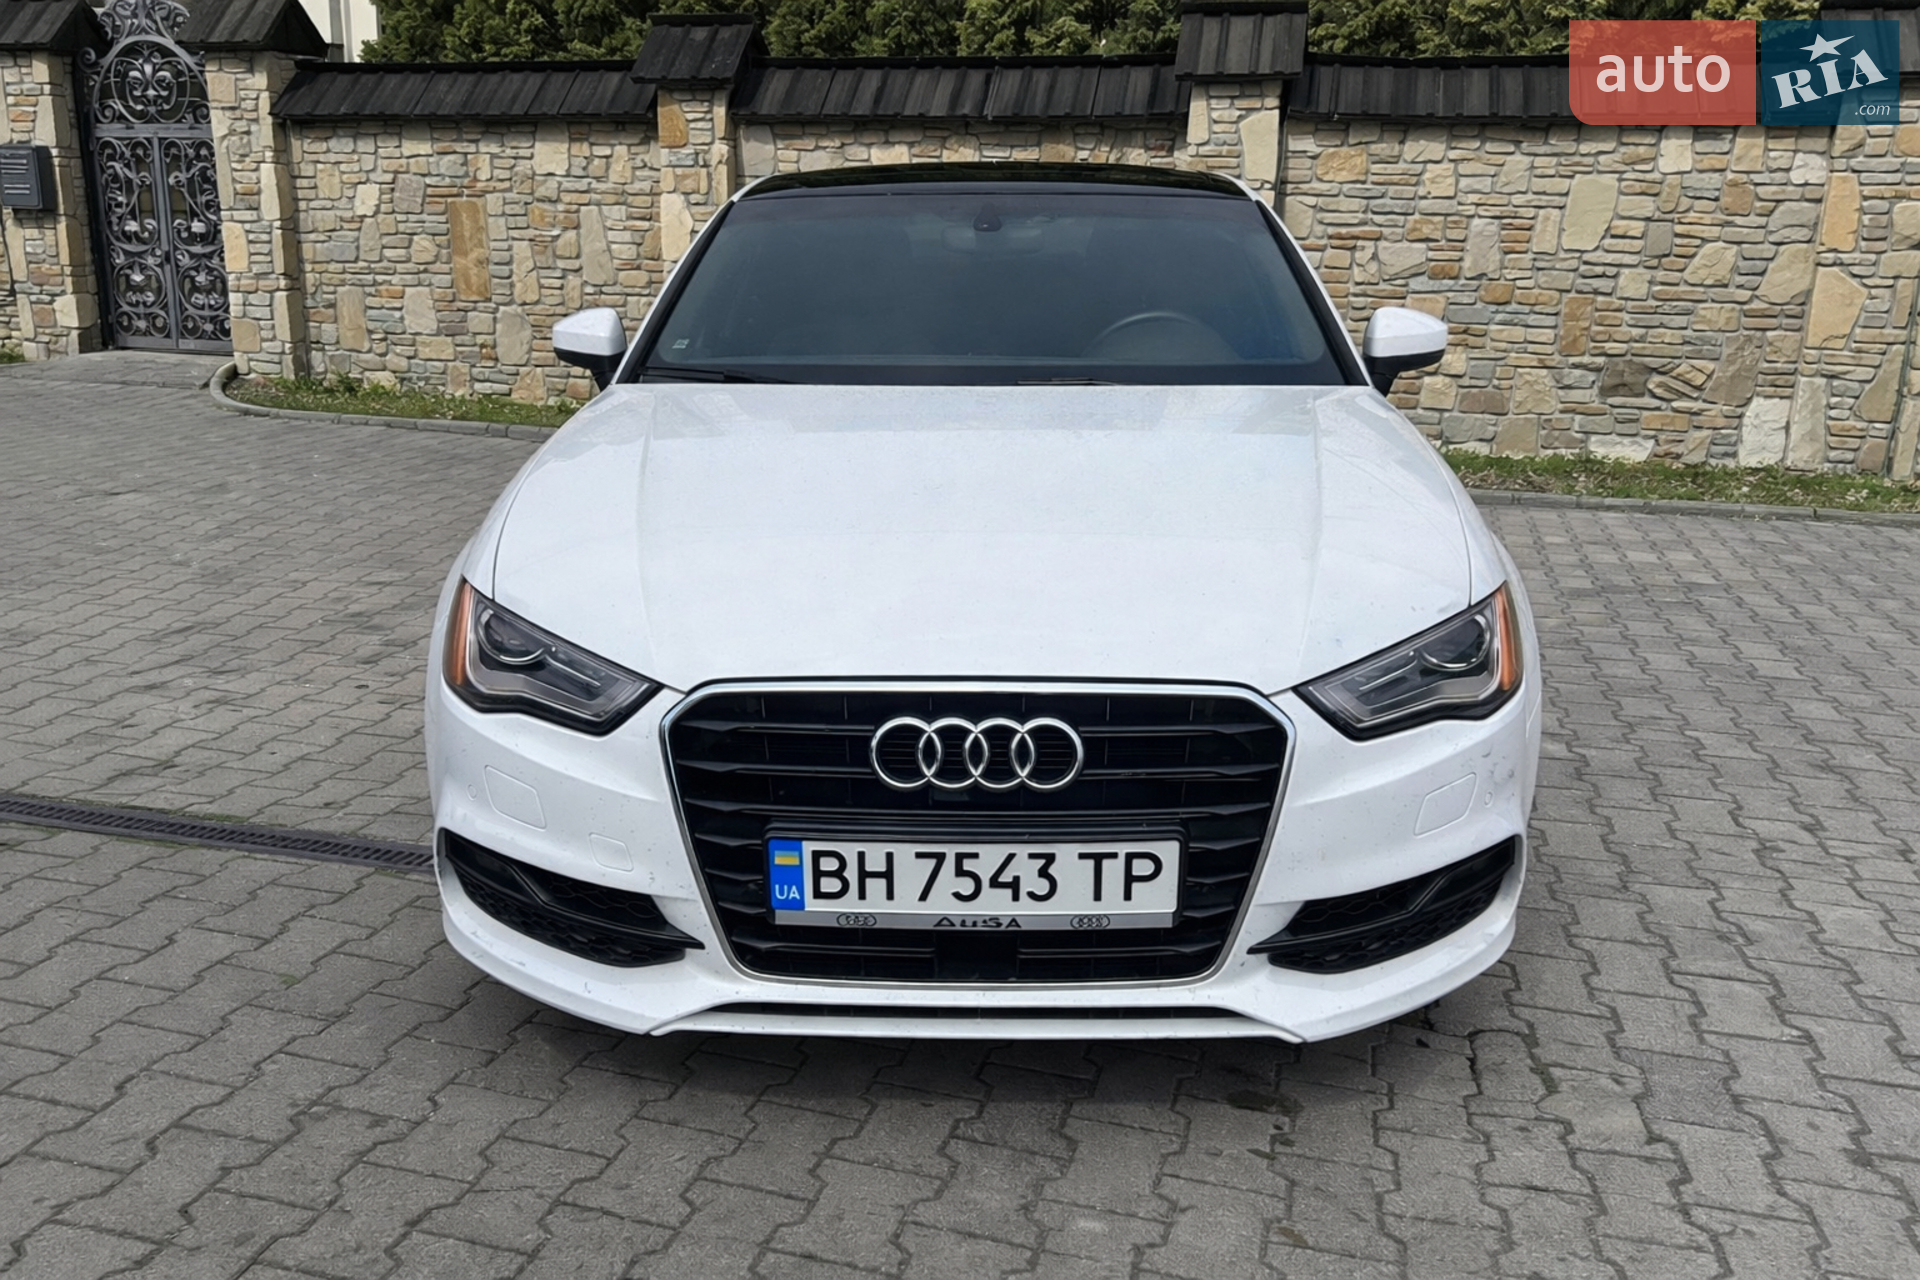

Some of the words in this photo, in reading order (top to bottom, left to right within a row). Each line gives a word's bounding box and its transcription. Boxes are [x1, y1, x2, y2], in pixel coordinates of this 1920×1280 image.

[775, 884, 801, 900] UA
[811, 850, 895, 901] BH
[914, 852, 1058, 902] 7543
[1077, 851, 1164, 902] TP
